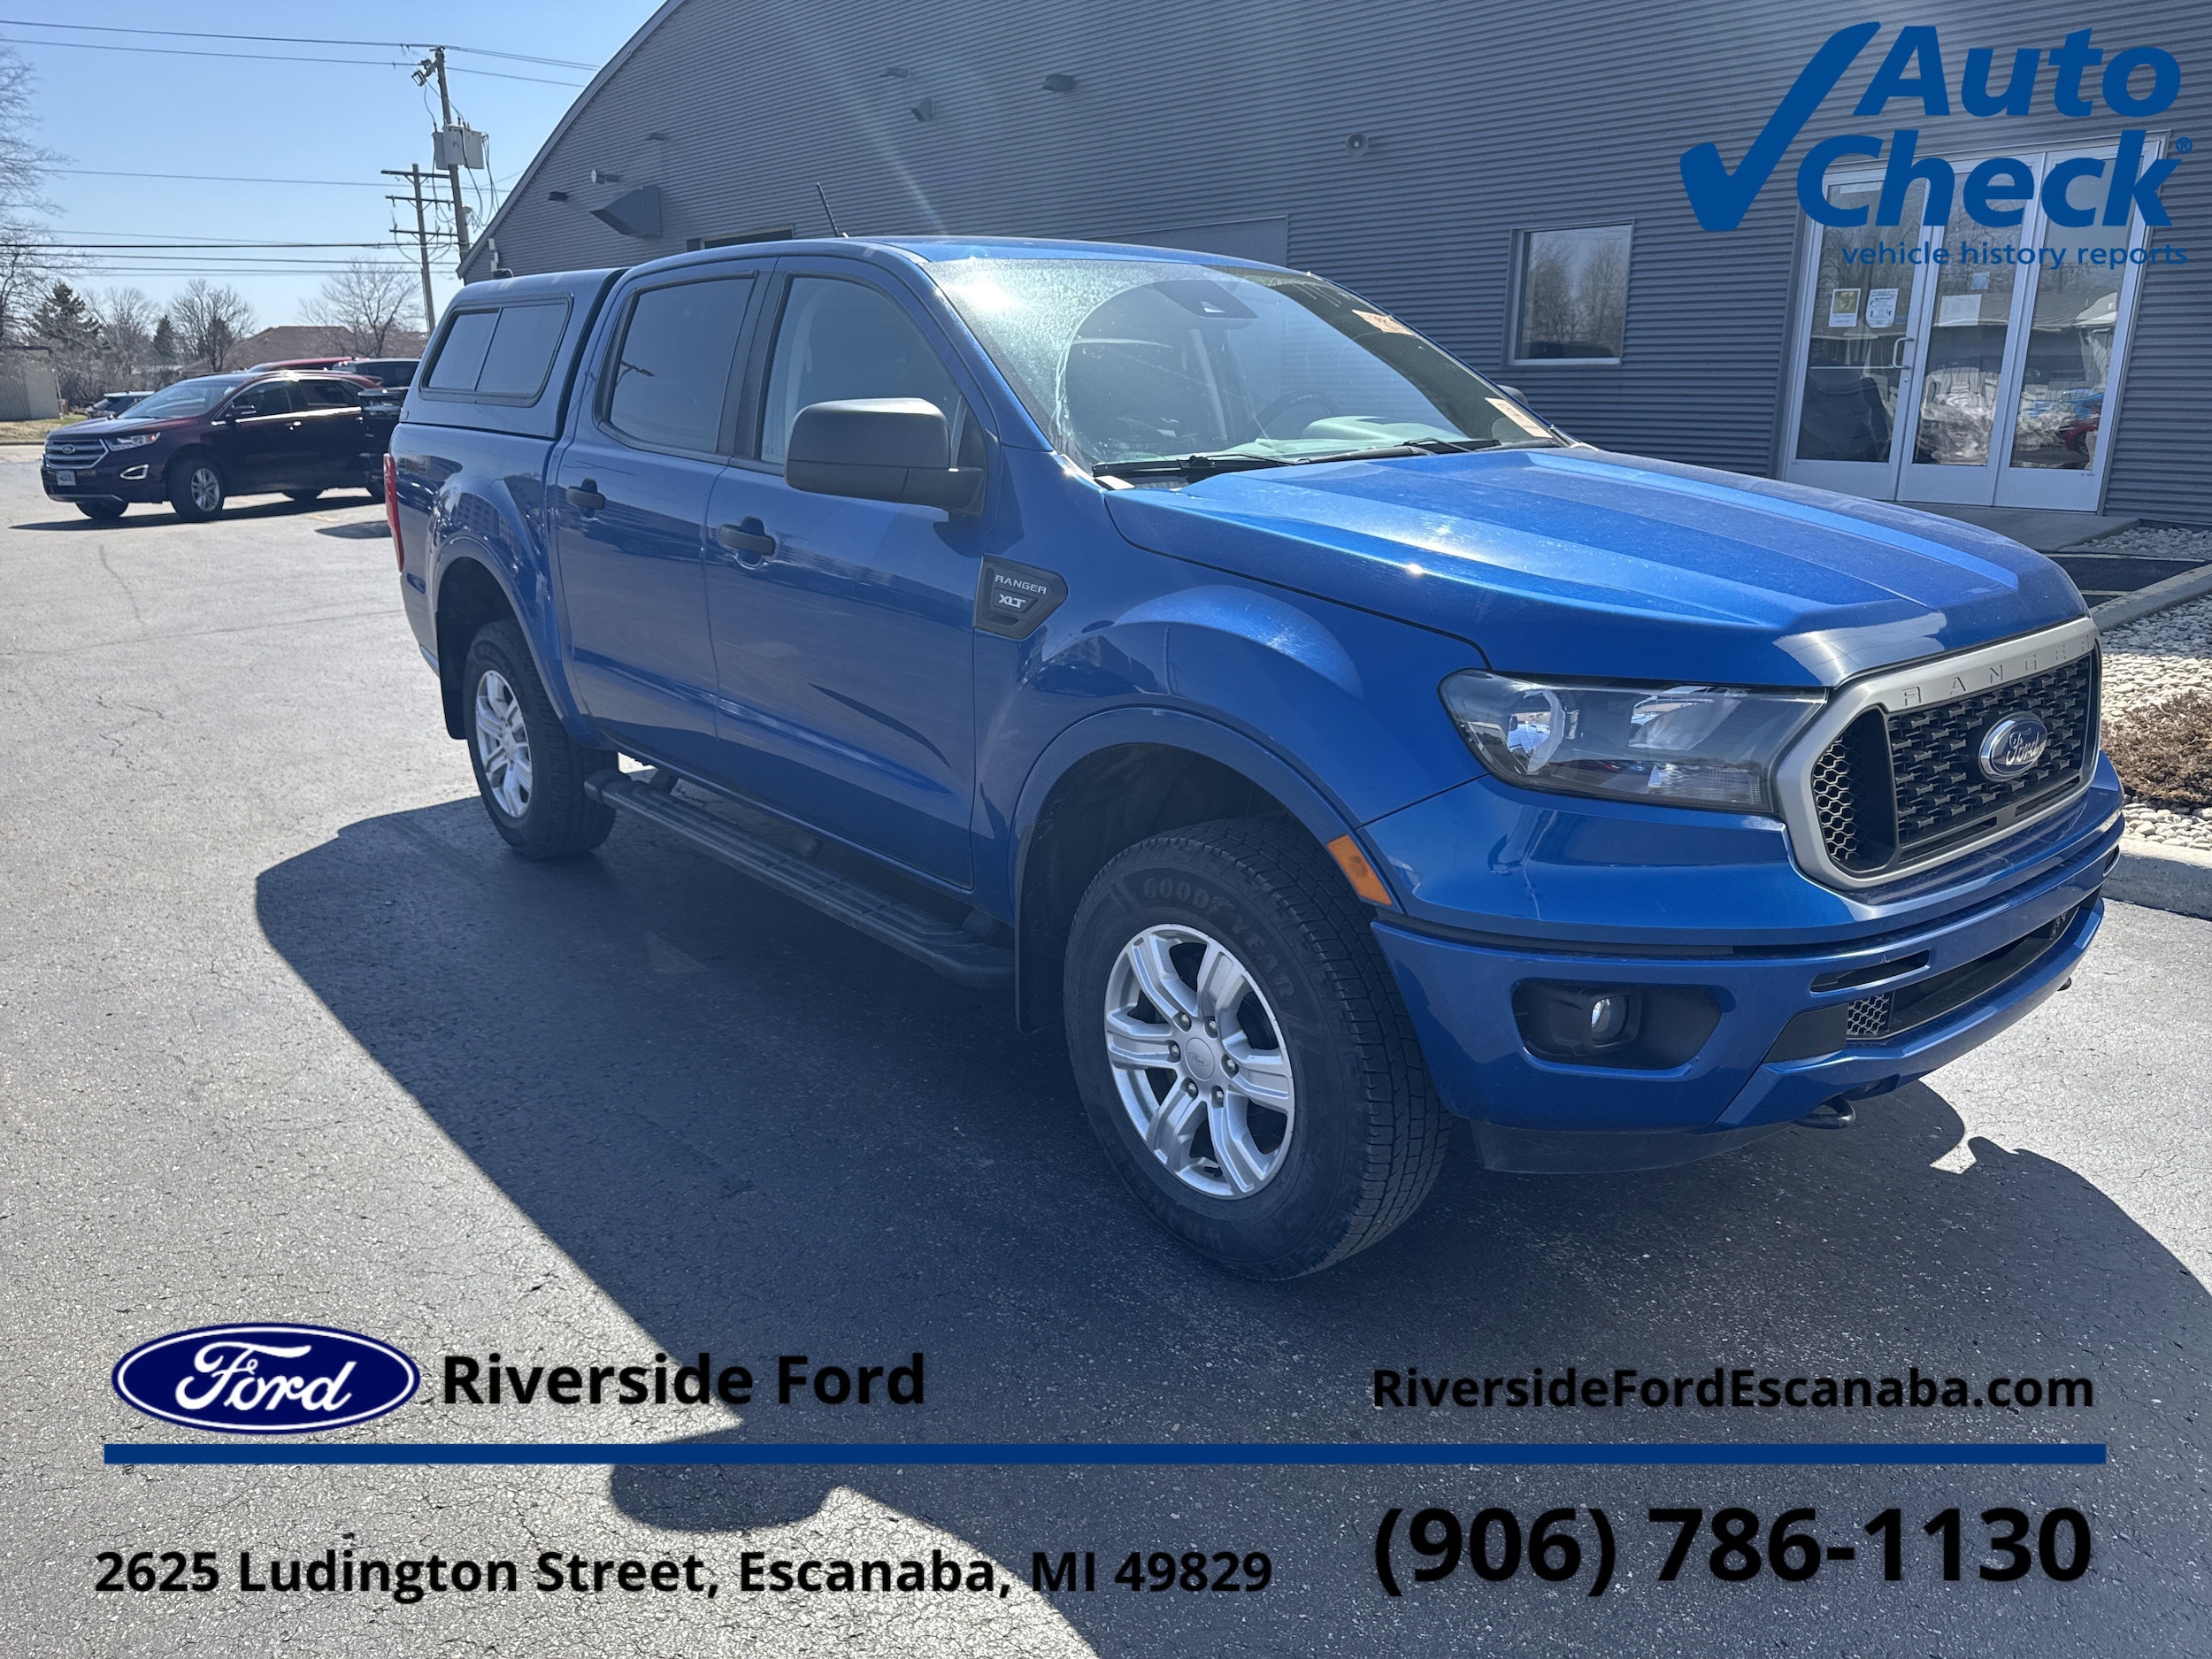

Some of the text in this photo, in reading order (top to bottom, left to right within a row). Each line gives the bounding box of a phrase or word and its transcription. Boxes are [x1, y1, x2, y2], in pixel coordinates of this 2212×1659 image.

[995, 574, 1048, 595] RANGER
[998, 594, 1026, 609] XLT
[1901, 634, 2092, 707] RANGER
[2005, 726, 2046, 767] Ford
